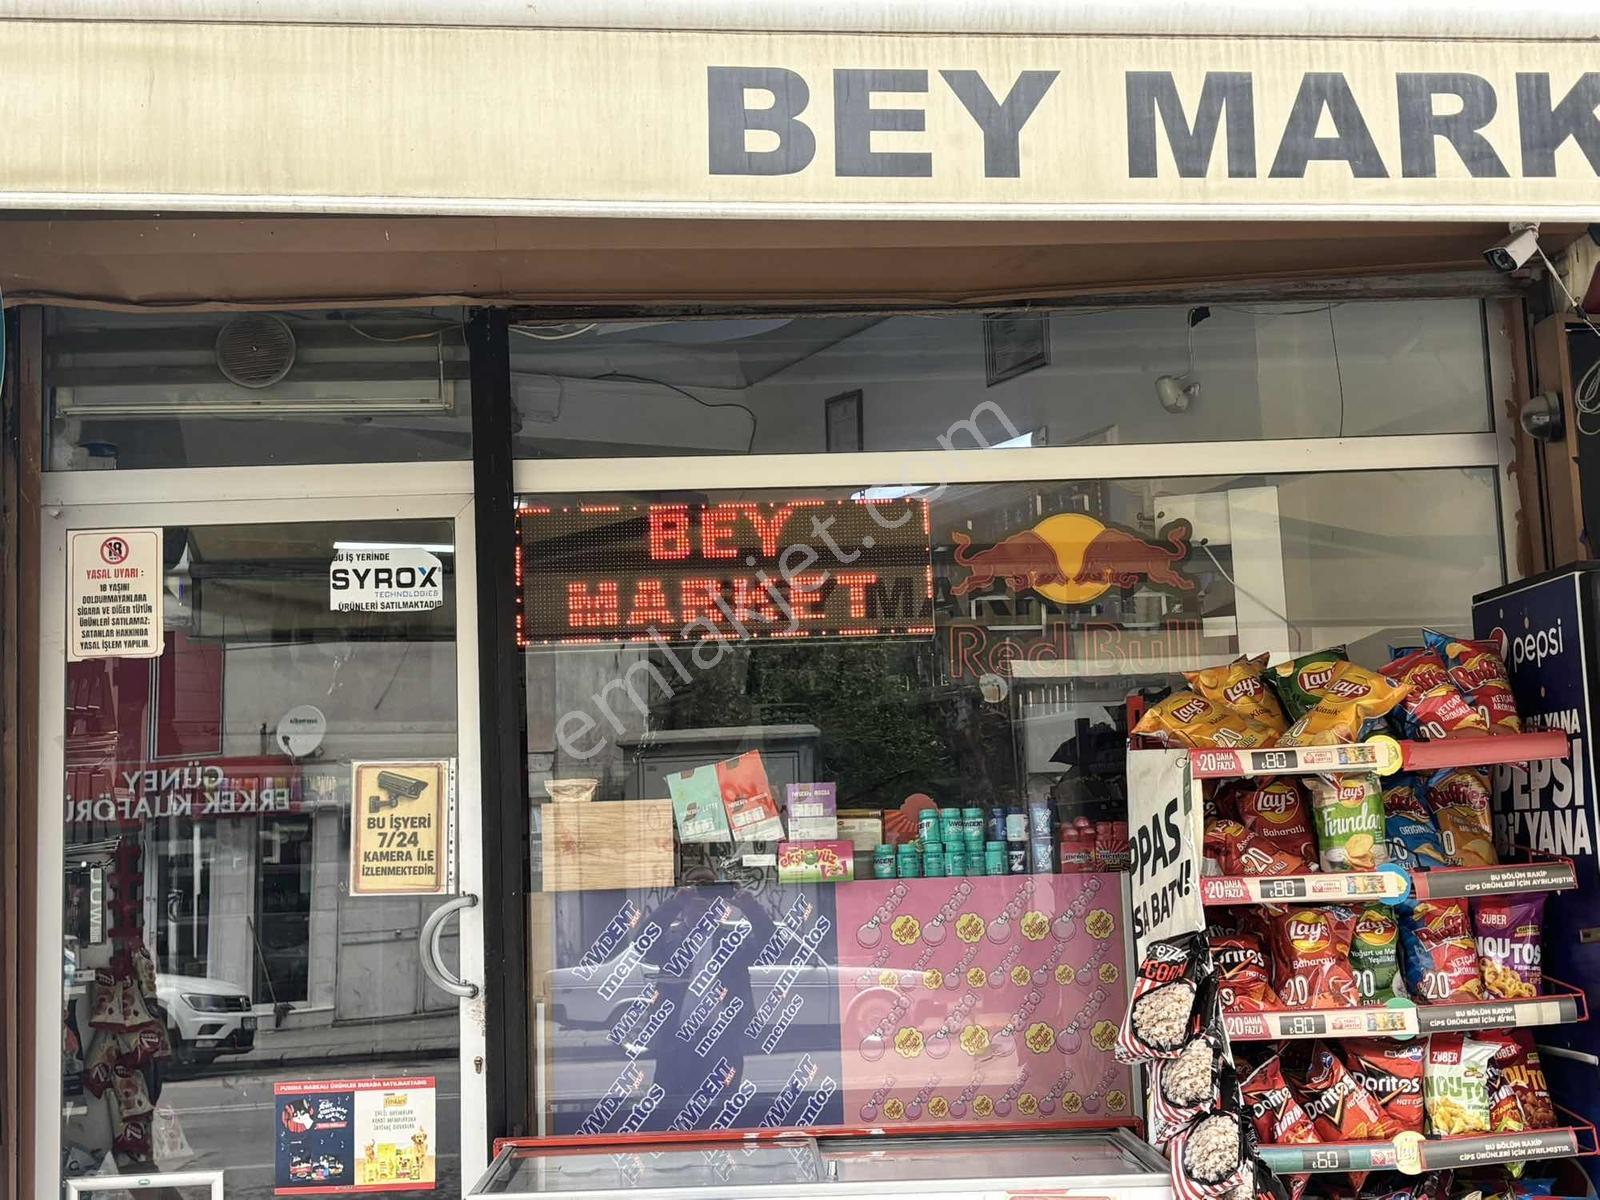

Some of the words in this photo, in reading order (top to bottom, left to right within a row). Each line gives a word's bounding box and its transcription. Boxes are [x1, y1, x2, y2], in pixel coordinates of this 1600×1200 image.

[705, 66, 1060, 177] BEY
[1124, 70, 1600, 179] MARK
[649, 506, 793, 560] BEY
[346, 552, 354, 563] İŞ
[356, 552, 390, 560] YERİNDE
[86, 568, 111, 580] YASAL
[114, 568, 138, 579] UYARI
[332, 567, 437, 590] SYROX
[100, 584, 108, 592] 18
[374, 590, 439, 598] TECHNOLOGIES
[567, 574, 878, 627] MARKET
[102, 606, 110, 615] VE
[82, 630, 114, 638] SATANLAR
[116, 628, 148, 637] HAKKINDA
[80, 641, 100, 650] YASAL
[950, 620, 1067, 678] Red
[1084, 618, 1200, 675] Bull
[1512, 618, 1564, 672] pepsi
[1216, 753, 1234, 761] DAHA
[1217, 761, 1236, 770] FAZLA
[367, 817, 385, 829] BU
[390, 813, 431, 832] İŞYERİ
[377, 831, 419, 848] 7/24
[1524, 808, 1593, 857] YANA
[363, 850, 413, 862] KAMERA
[417, 848, 434, 861] İLE
[1501, 872, 1525, 881] BÖLÜM
[1527, 870, 1547, 878] RAKİP
[1223, 880, 1241, 889] DAHA
[1465, 883, 1480, 891] CİPS
[1482, 880, 1516, 890] ÜRÜNLERİ
[1517, 879, 1531, 888] İÇİN
[1224, 888, 1244, 898] FAZLA
[597, 921, 662, 1001] mentos
[688, 916, 753, 998] mentos
[772, 915, 831, 996] mentos
[1466, 1008, 1491, 1017] BÖLÜM
[1492, 1006, 1513, 1014] RAKİP
[695, 995, 744, 1058] mentos
[761, 993, 805, 1055] mentos
[1244, 1016, 1261, 1025] DAHA
[1429, 1019, 1445, 1027] CİPS
[1446, 1016, 1481, 1026] ÜRÜNLERİ
[1481, 1015, 1496, 1024] İÇİN
[1244, 1025, 1263, 1034] FAZLA
[1352, 1071, 1421, 1094] Doritos
[1424, 1075, 1490, 1102] NOUTO
[617, 1083, 665, 1134] entos
[709, 1080, 757, 1131] entos
[796, 1076, 837, 1128] entos
[1496, 1140, 1521, 1150] BÖLÜM
[1521, 1138, 1542, 1147] RAKİP
[1460, 1153, 1475, 1161] CİPS
[1476, 1150, 1510, 1160] ÜRÜNLERİ
[1512, 1148, 1526, 1157] İÇİN
